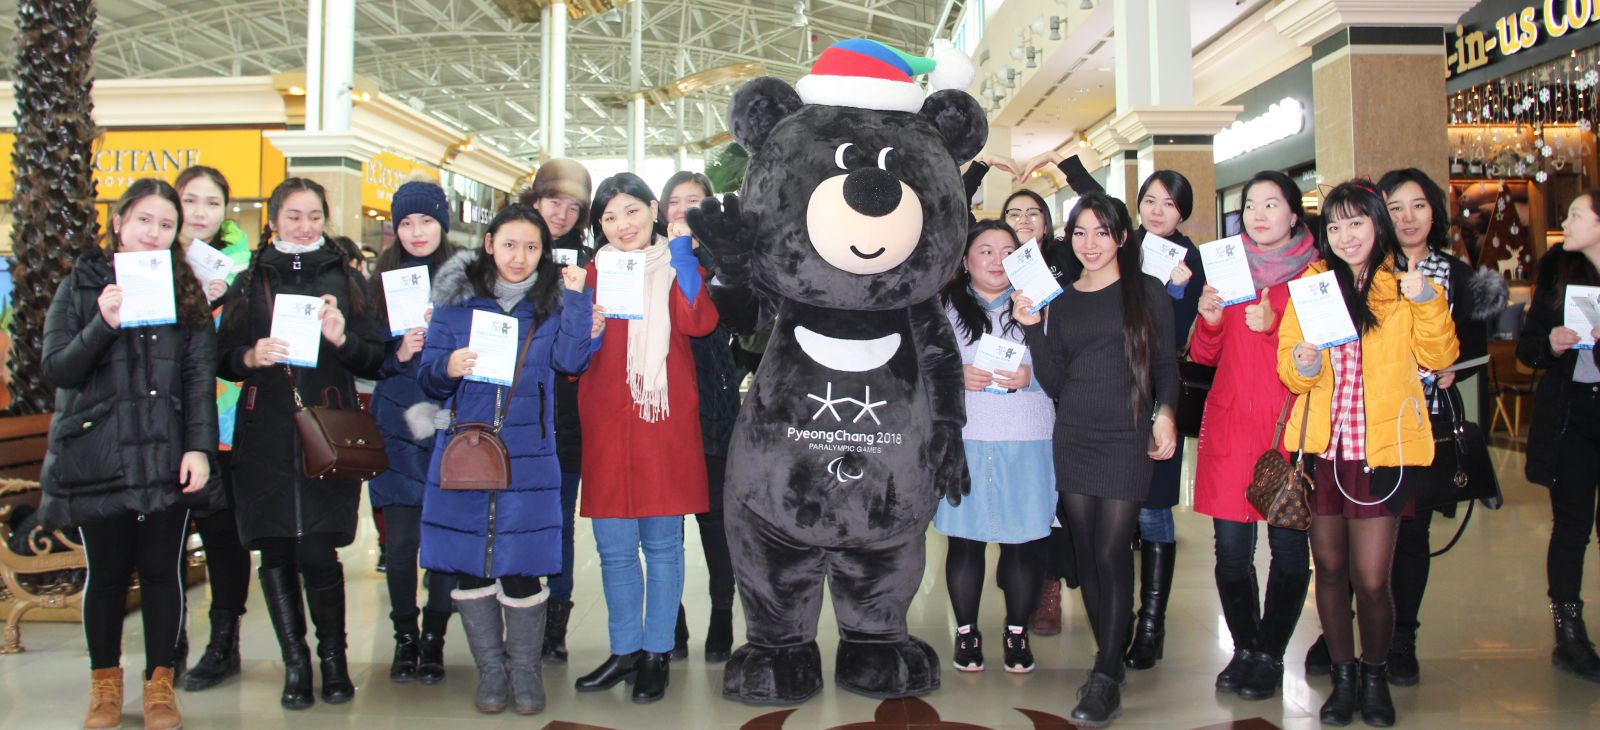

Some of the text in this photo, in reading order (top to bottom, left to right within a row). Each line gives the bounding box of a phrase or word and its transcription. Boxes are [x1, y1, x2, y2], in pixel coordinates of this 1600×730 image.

[1443, 6, 1538, 79] -in-us
[787, 427, 902, 446] PyeongChang 2018
[808, 442, 882, 454] PARALYMPIC GAMES
